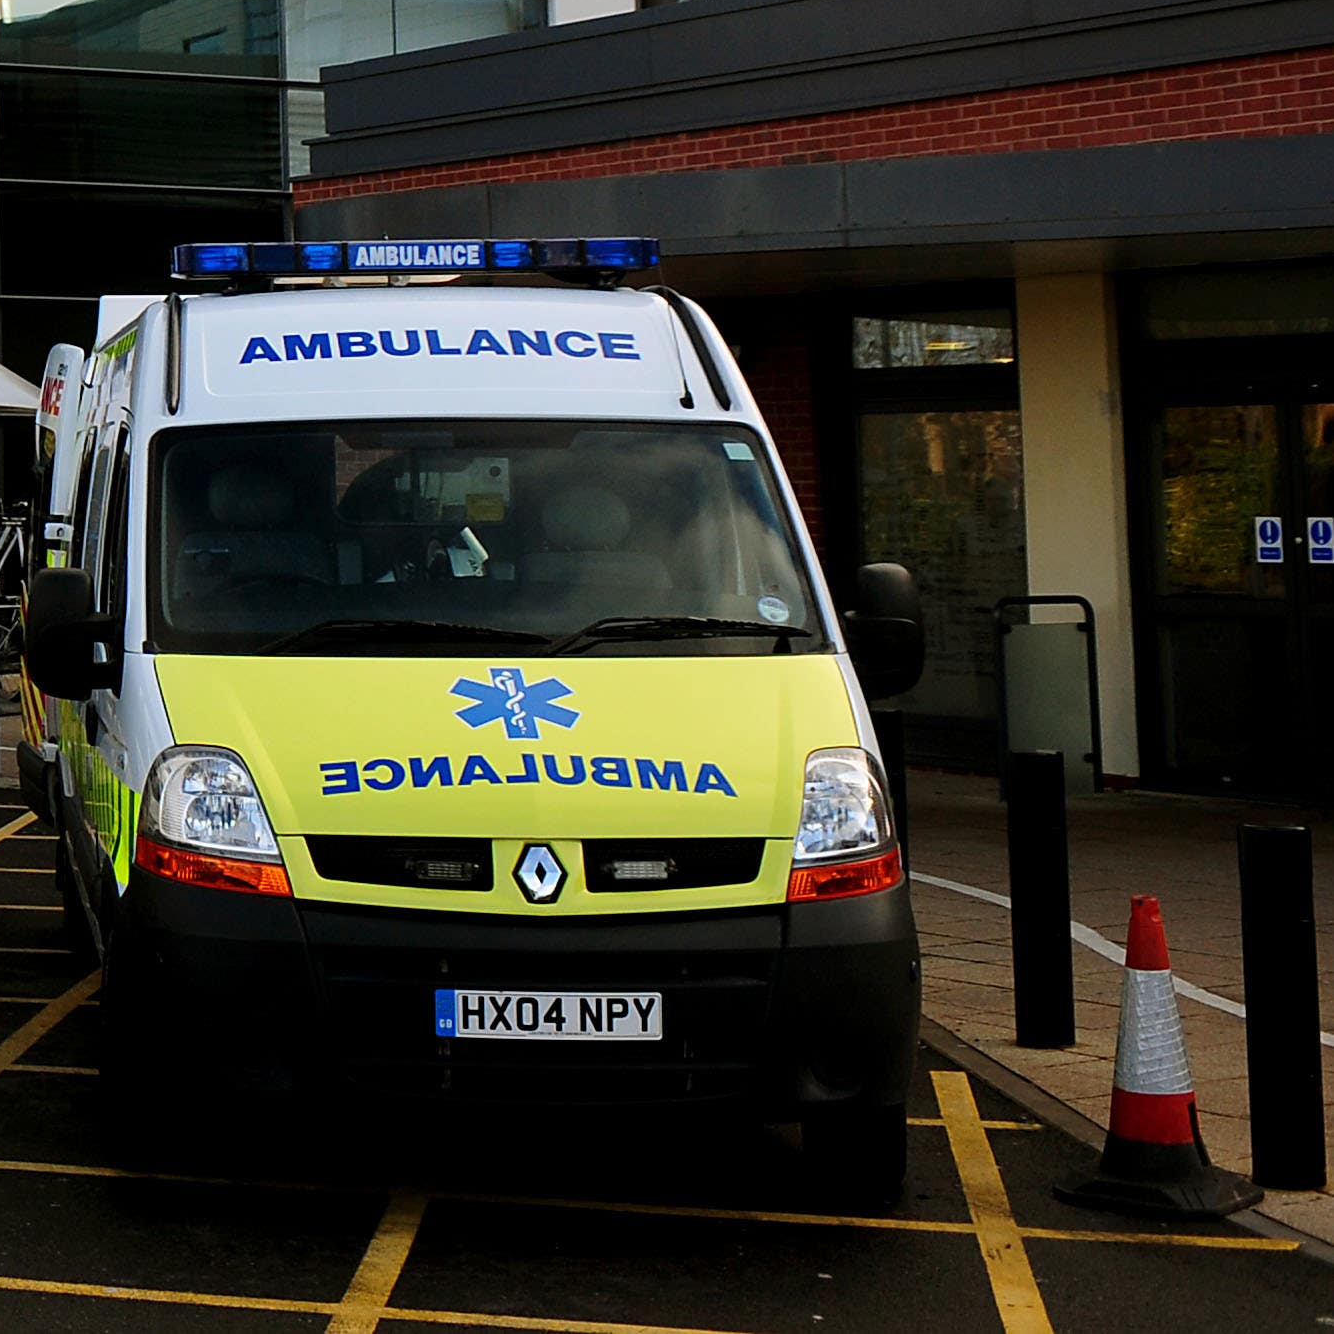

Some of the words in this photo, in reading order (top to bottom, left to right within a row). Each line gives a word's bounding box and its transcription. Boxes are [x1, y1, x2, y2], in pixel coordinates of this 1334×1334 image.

[355, 244, 480, 266] AMBULANCE
[239, 329, 641, 365] AMBULANCE
[439, 1018, 453, 1028] GB
[461, 996, 566, 1032] HX04
[580, 998, 656, 1032] NPY
